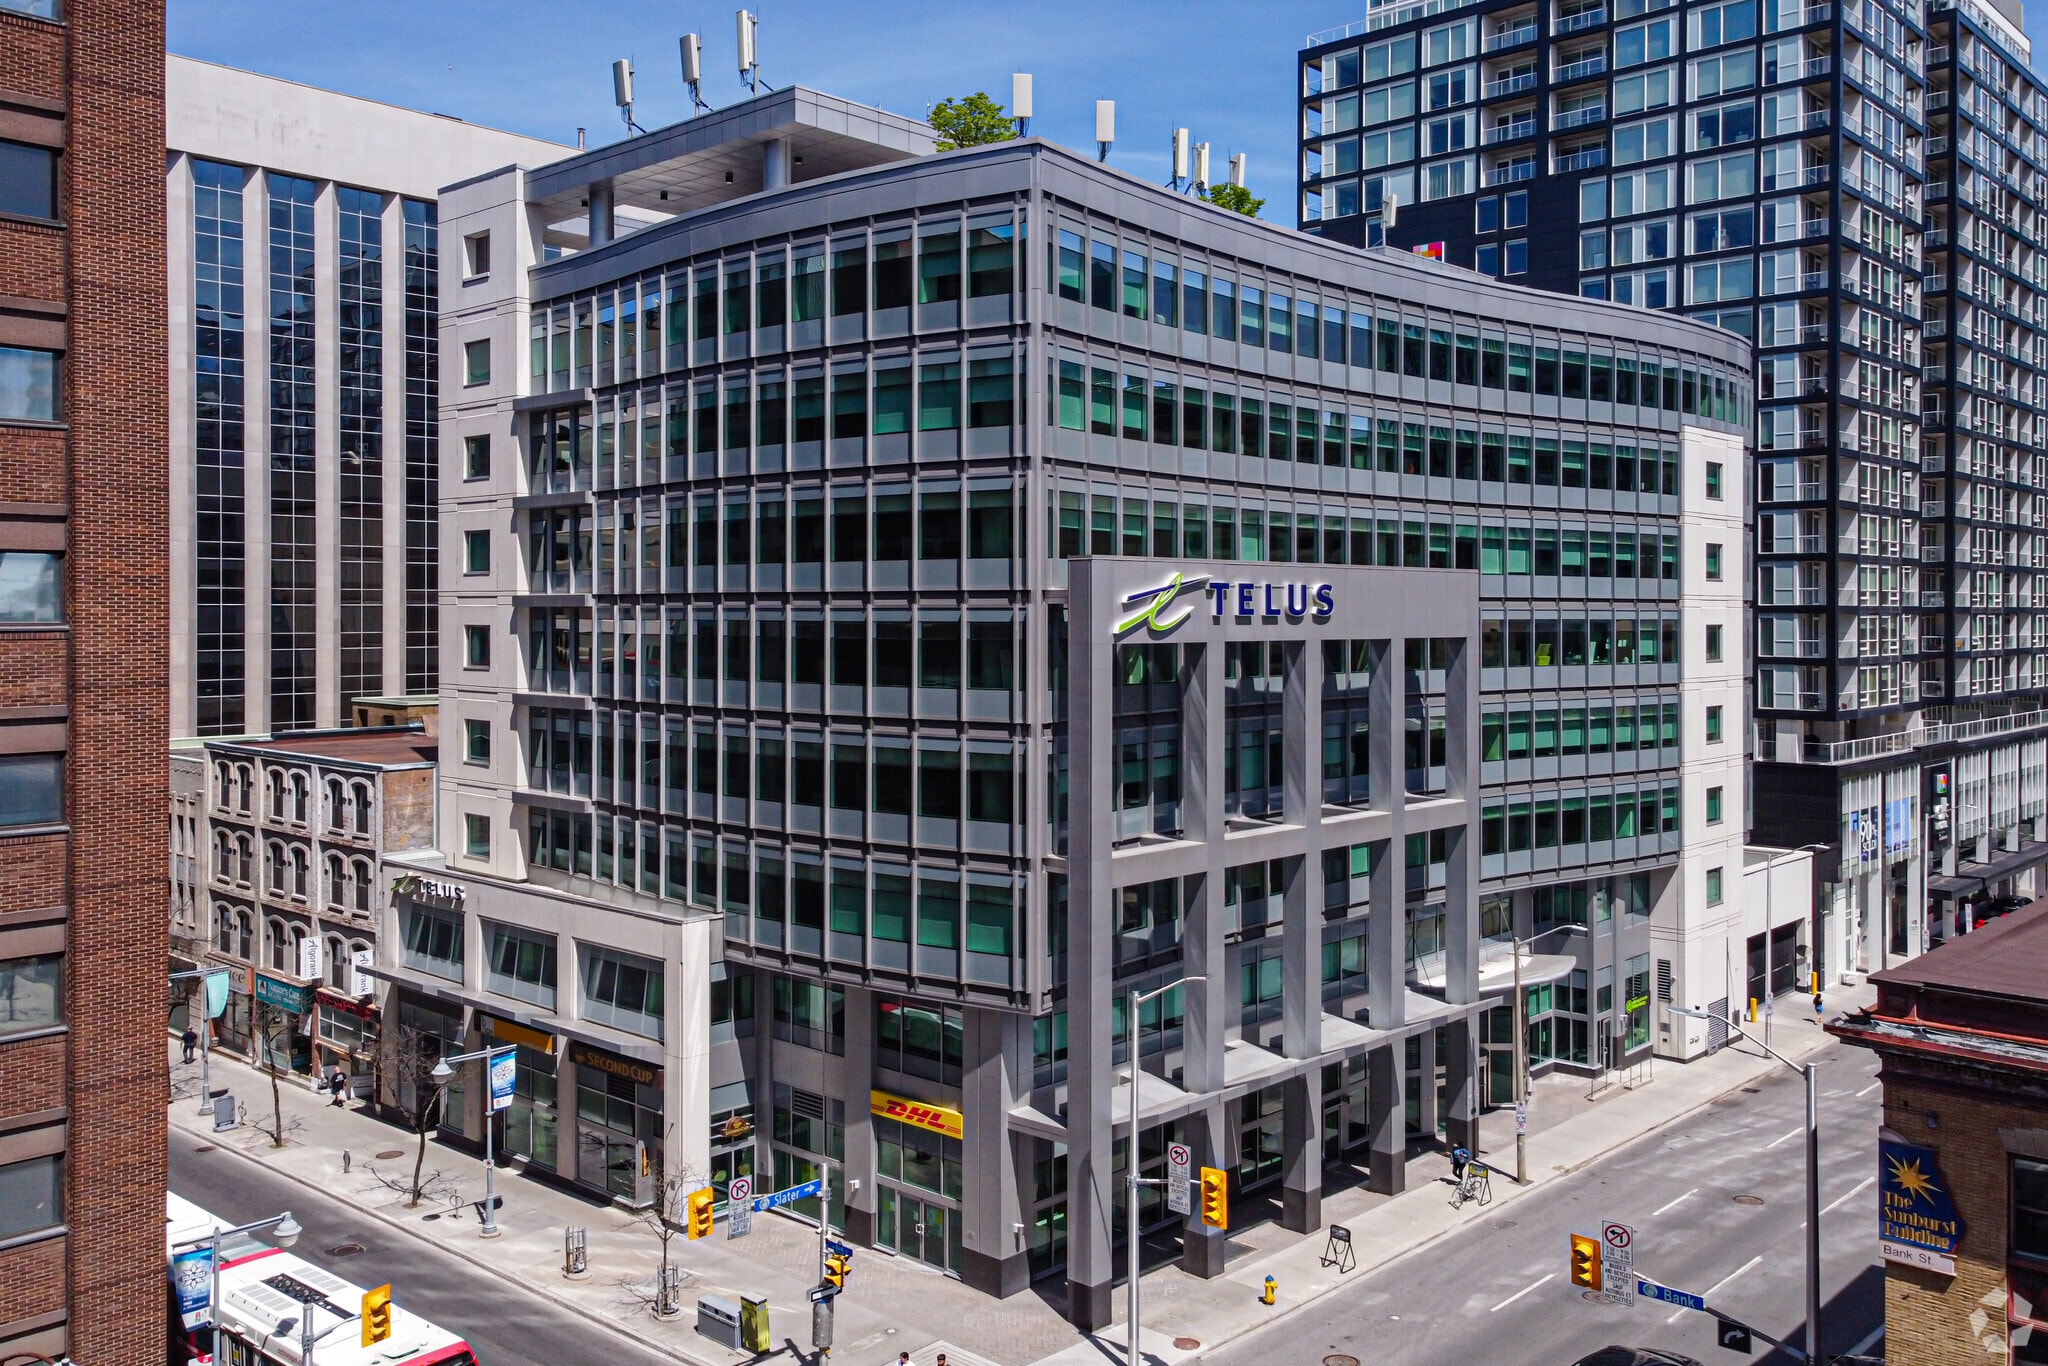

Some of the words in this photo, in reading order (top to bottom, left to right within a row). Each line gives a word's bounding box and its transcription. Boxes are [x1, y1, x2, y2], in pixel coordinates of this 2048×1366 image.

[1209, 582, 1335, 617] TELUS
[418, 877, 466, 901] TELUS
[308, 939, 318, 978] Algorank
[360, 953, 369, 993] Alrank
[588, 1053, 630, 1076] SECOND
[630, 1065, 653, 1083] CUP
[886, 1099, 946, 1130] DHL
[774, 1189, 801, 1207] Slater
[1884, 1191, 1913, 1209] The
[1883, 1206, 1957, 1236] Sunburst
[1884, 1222, 1950, 1249] Building
[1883, 1244, 1913, 1260] Bank
[1663, 1288, 1696, 1309] Bank
